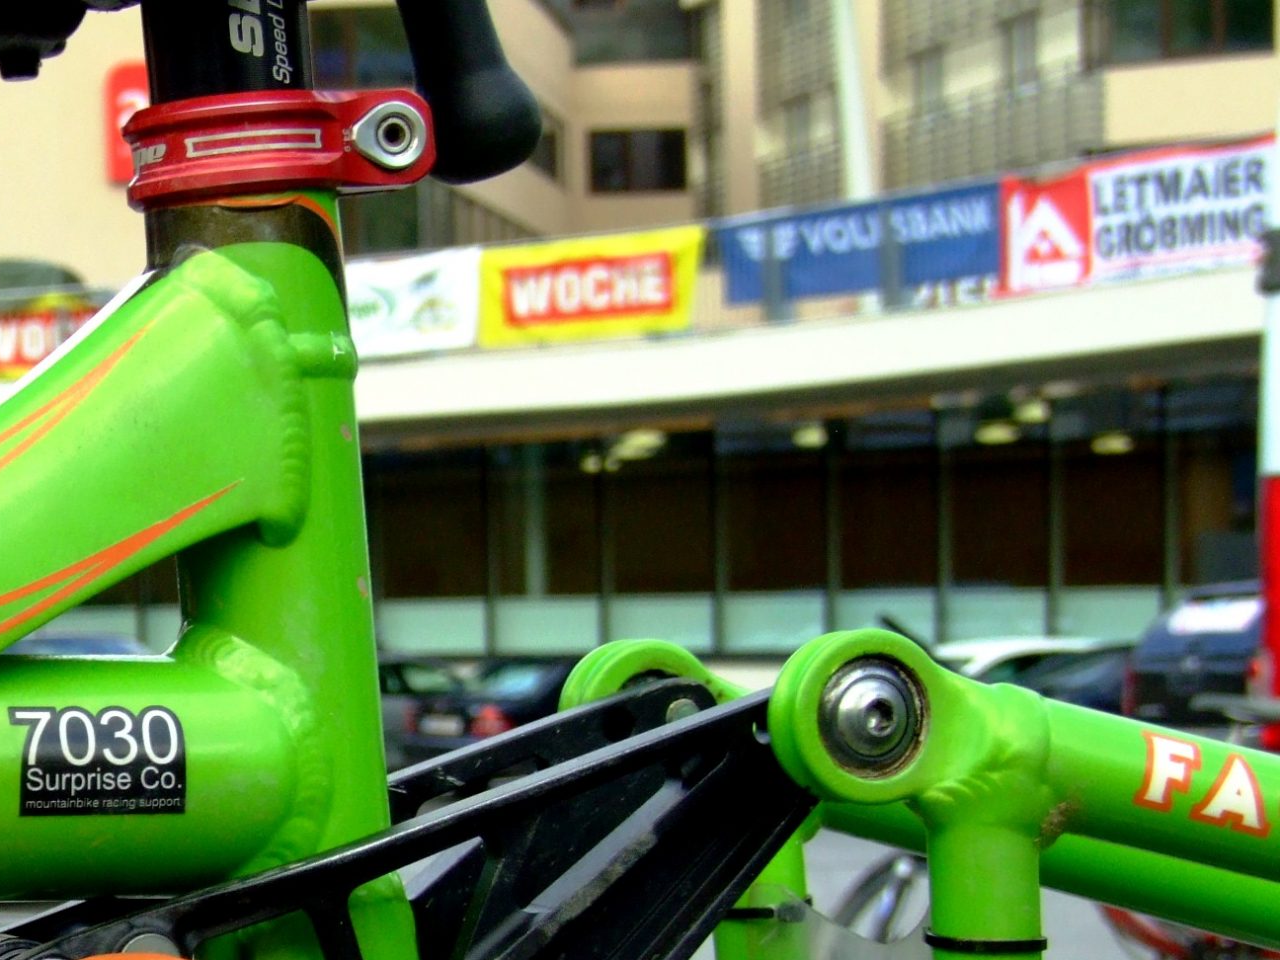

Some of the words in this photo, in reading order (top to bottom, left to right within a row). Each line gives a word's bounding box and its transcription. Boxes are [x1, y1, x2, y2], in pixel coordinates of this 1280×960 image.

[267, 12, 294, 84] Speed
[510, 261, 665, 318] WOCHE
[14, 709, 179, 767] 7030
[25, 797, 100, 809] mountainbike
[102, 797, 137, 810] racing
[139, 796, 182, 809] support
[26, 767, 133, 797] Surprise
[140, 766, 183, 790] Co.
[1133, 729, 1280, 840] FA
